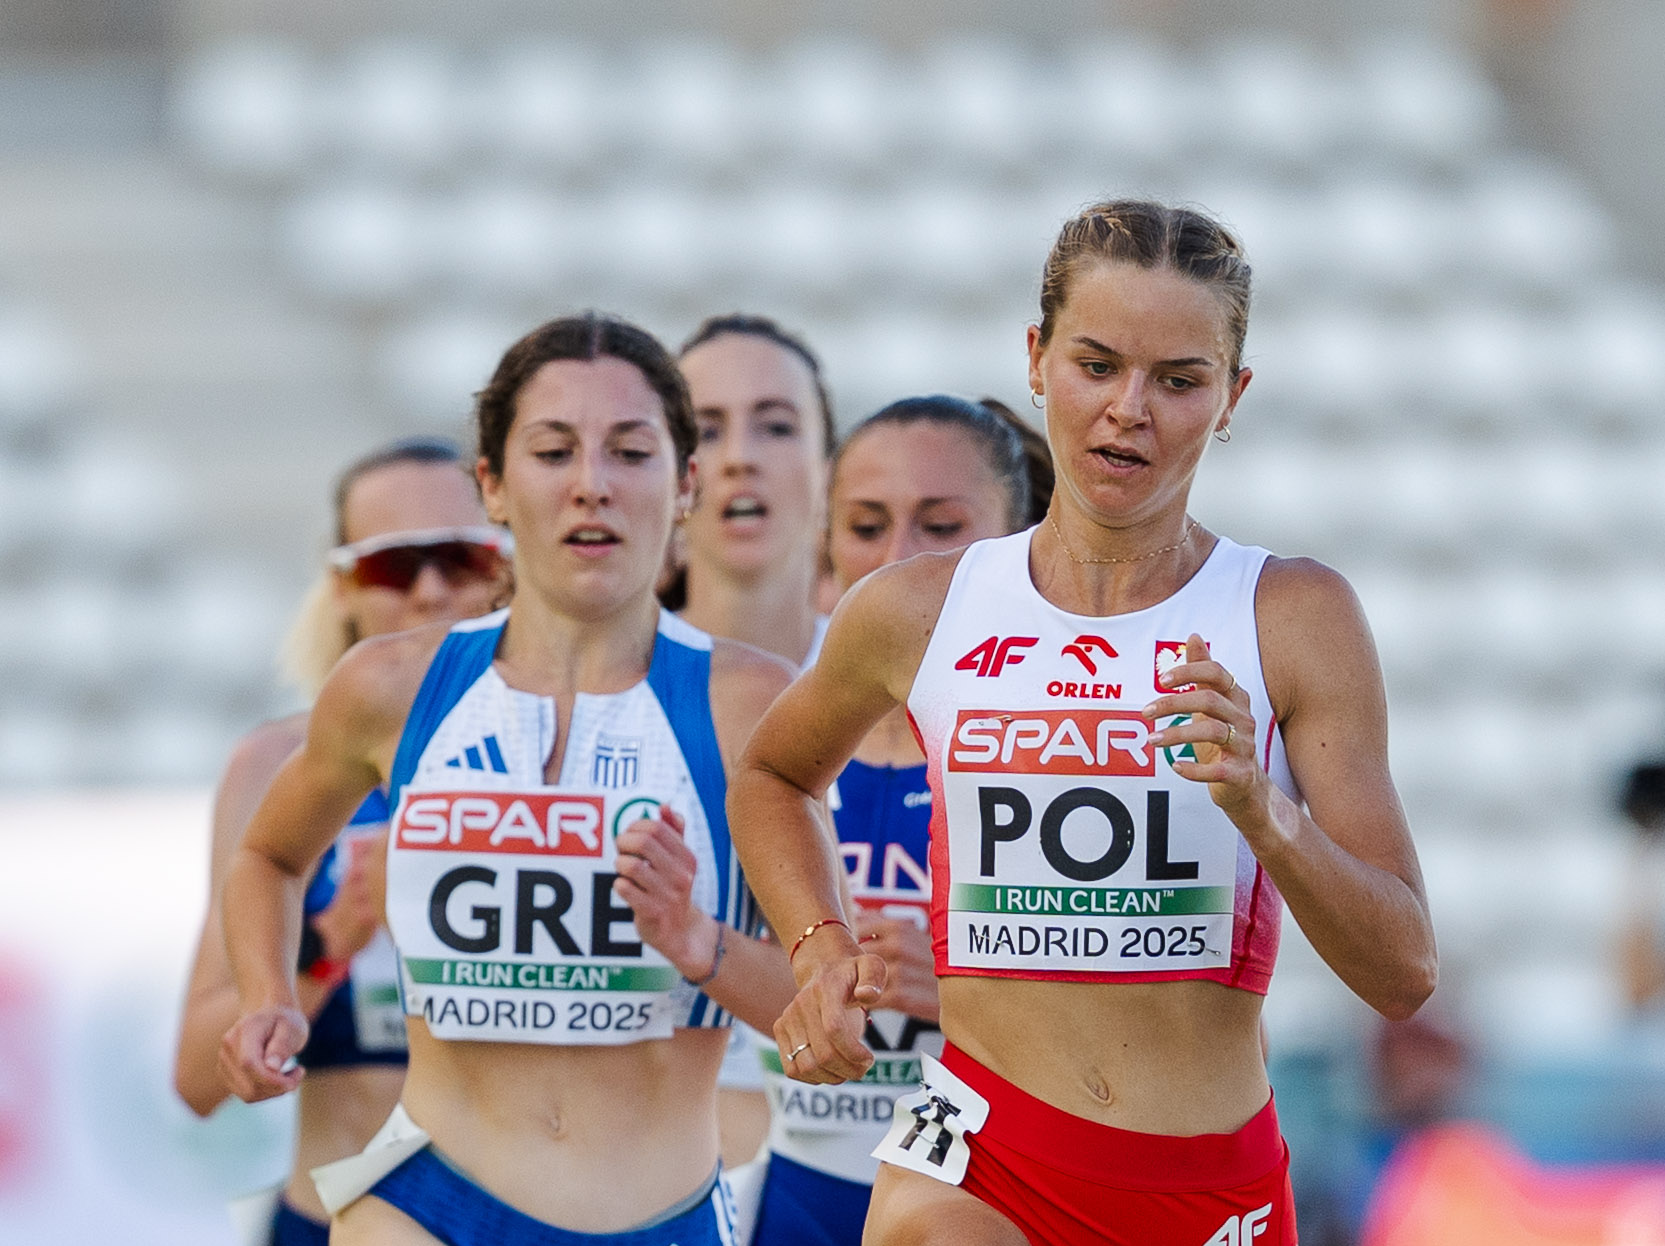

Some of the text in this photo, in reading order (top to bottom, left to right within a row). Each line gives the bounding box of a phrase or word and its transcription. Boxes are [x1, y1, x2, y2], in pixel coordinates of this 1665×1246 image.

[955, 636, 1040, 678] 4F
[1046, 680, 1122, 700] ORLEN
[953, 718, 1149, 767] SPAR
[401, 798, 599, 850] SPAR
[978, 786, 1199, 882] POL
[429, 865, 643, 958] GRE
[996, 888, 1001, 910] I
[1007, 888, 1062, 912] RUN
[968, 923, 1207, 958] MADRID 2025
[442, 961, 450, 983] I
[455, 962, 514, 986] RUN
[568, 1002, 653, 1031] 2025
[779, 1088, 894, 1122] ADRID
